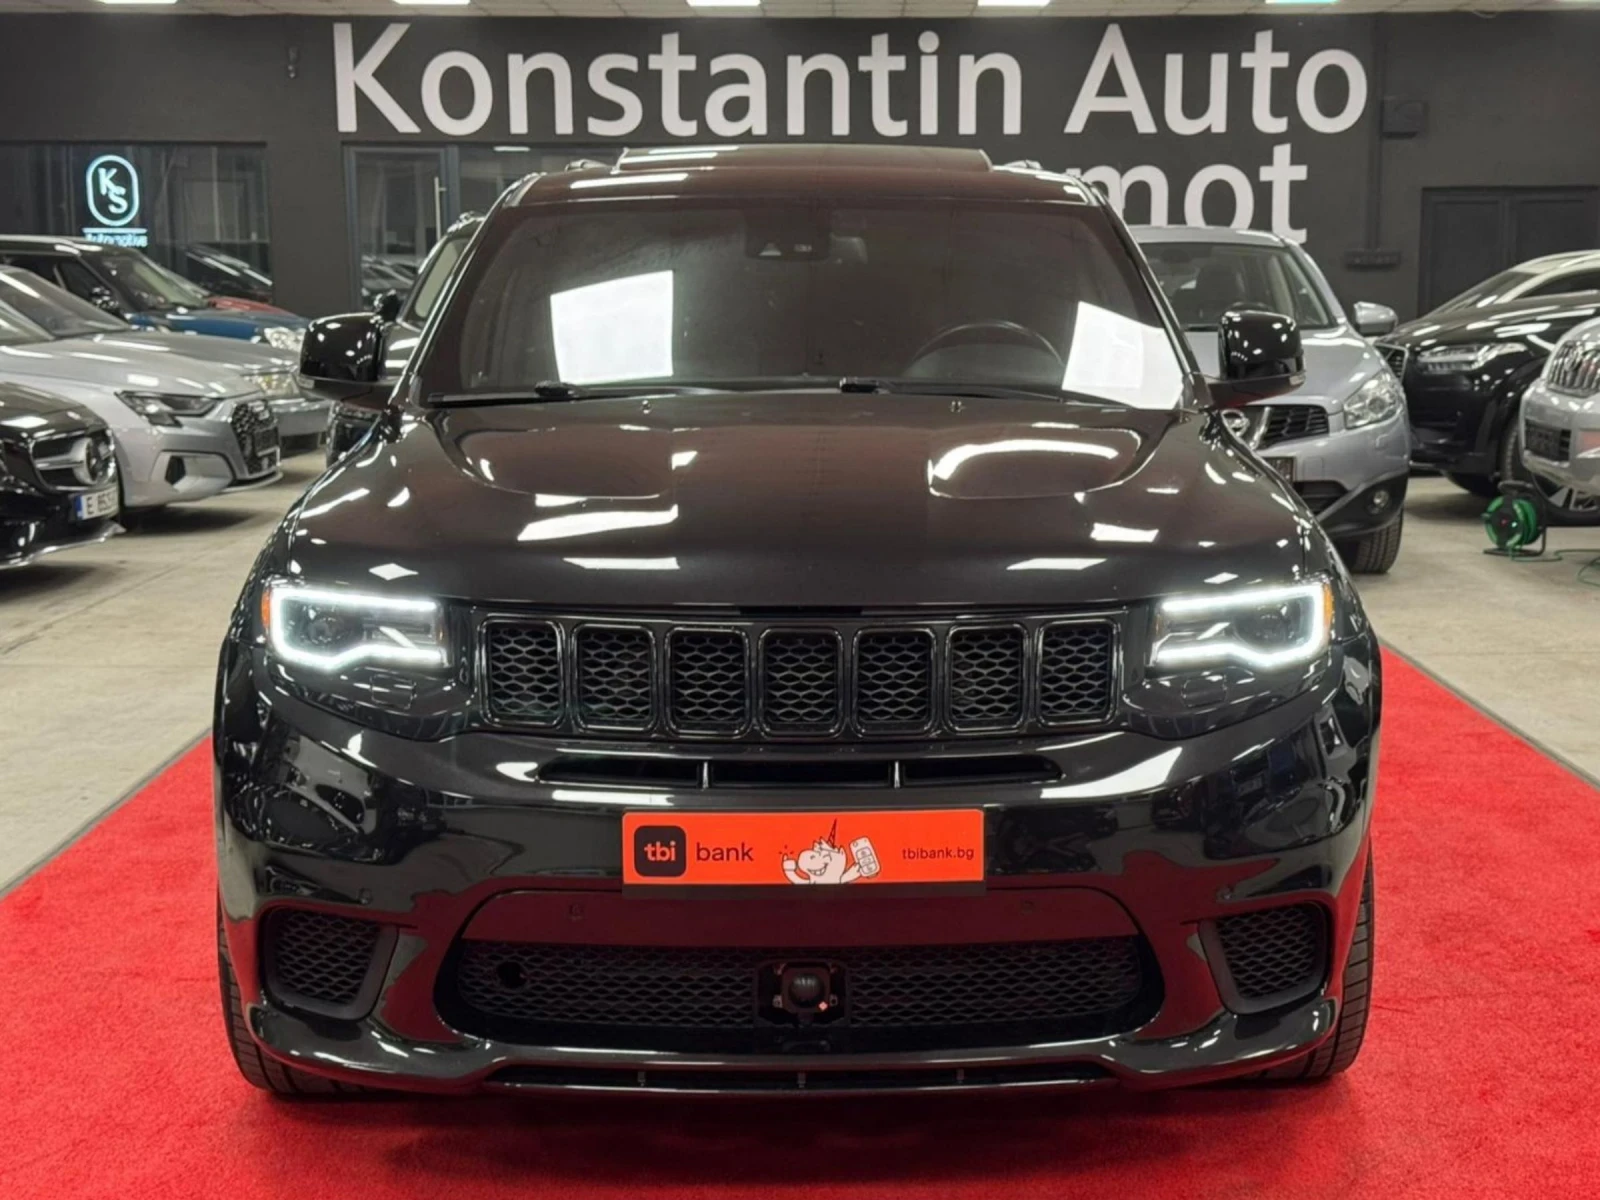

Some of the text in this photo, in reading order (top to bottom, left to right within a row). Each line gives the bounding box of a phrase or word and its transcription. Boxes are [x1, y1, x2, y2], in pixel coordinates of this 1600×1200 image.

[335, 23, 1368, 136] Konstantin Auto
[644, 841, 754, 862] tbi bank
[902, 847, 975, 861] tbibank.bg
